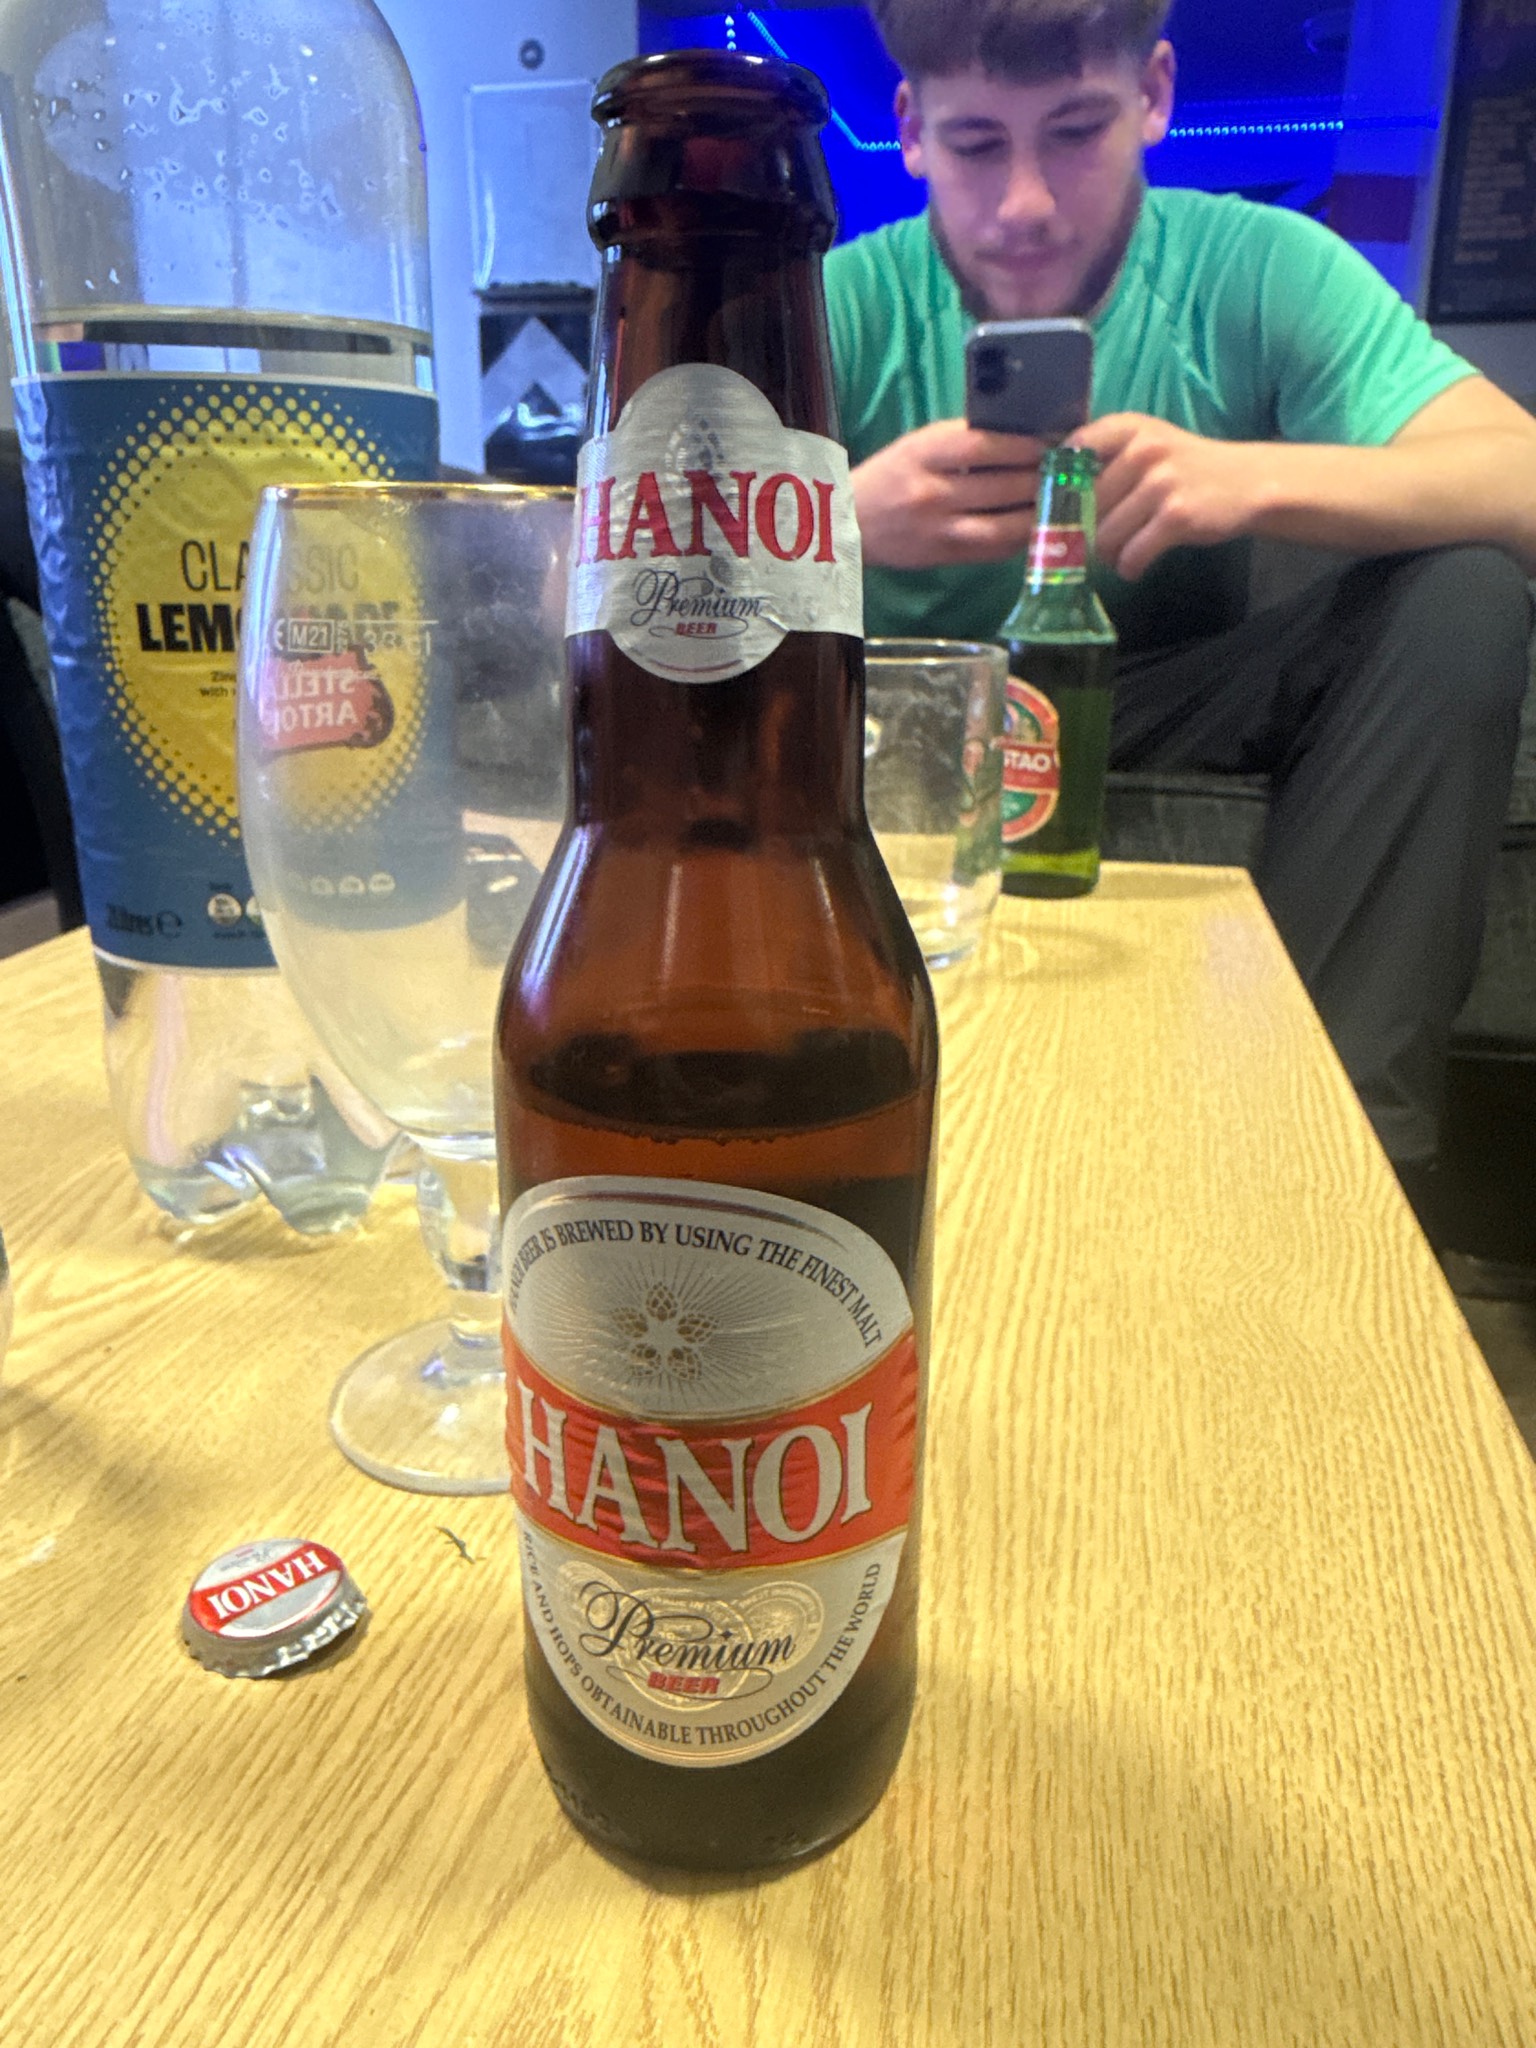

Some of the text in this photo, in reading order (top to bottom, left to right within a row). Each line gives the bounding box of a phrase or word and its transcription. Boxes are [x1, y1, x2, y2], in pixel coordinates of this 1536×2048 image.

[577, 470, 837, 567] HANOI
[631, 568, 762, 627] Premium
[675, 622, 718, 635] BEER
[539, 1227, 557, 1253] IS
[553, 1219, 634, 1247] BREWED
[639, 1220, 669, 1244] BY
[675, 1223, 753, 1256] USING
[756, 1238, 804, 1271] THE
[798, 1254, 859, 1305] FINEST
[847, 1294, 882, 1349] MALT
[516, 1378, 874, 1553] HANOI
[207, 1550, 328, 1620] HANOI
[579, 1580, 797, 1670] Premium
[533, 1580, 554, 1624] AND
[550, 1626, 583, 1677] HOPS
[581, 1675, 692, 1745] OBTAINABLE
[695, 1670, 828, 1746] THROUGHOUT
[820, 1625, 856, 1673] THE
[844, 1563, 881, 1638] WORLD
[646, 1670, 721, 1695] BEER
